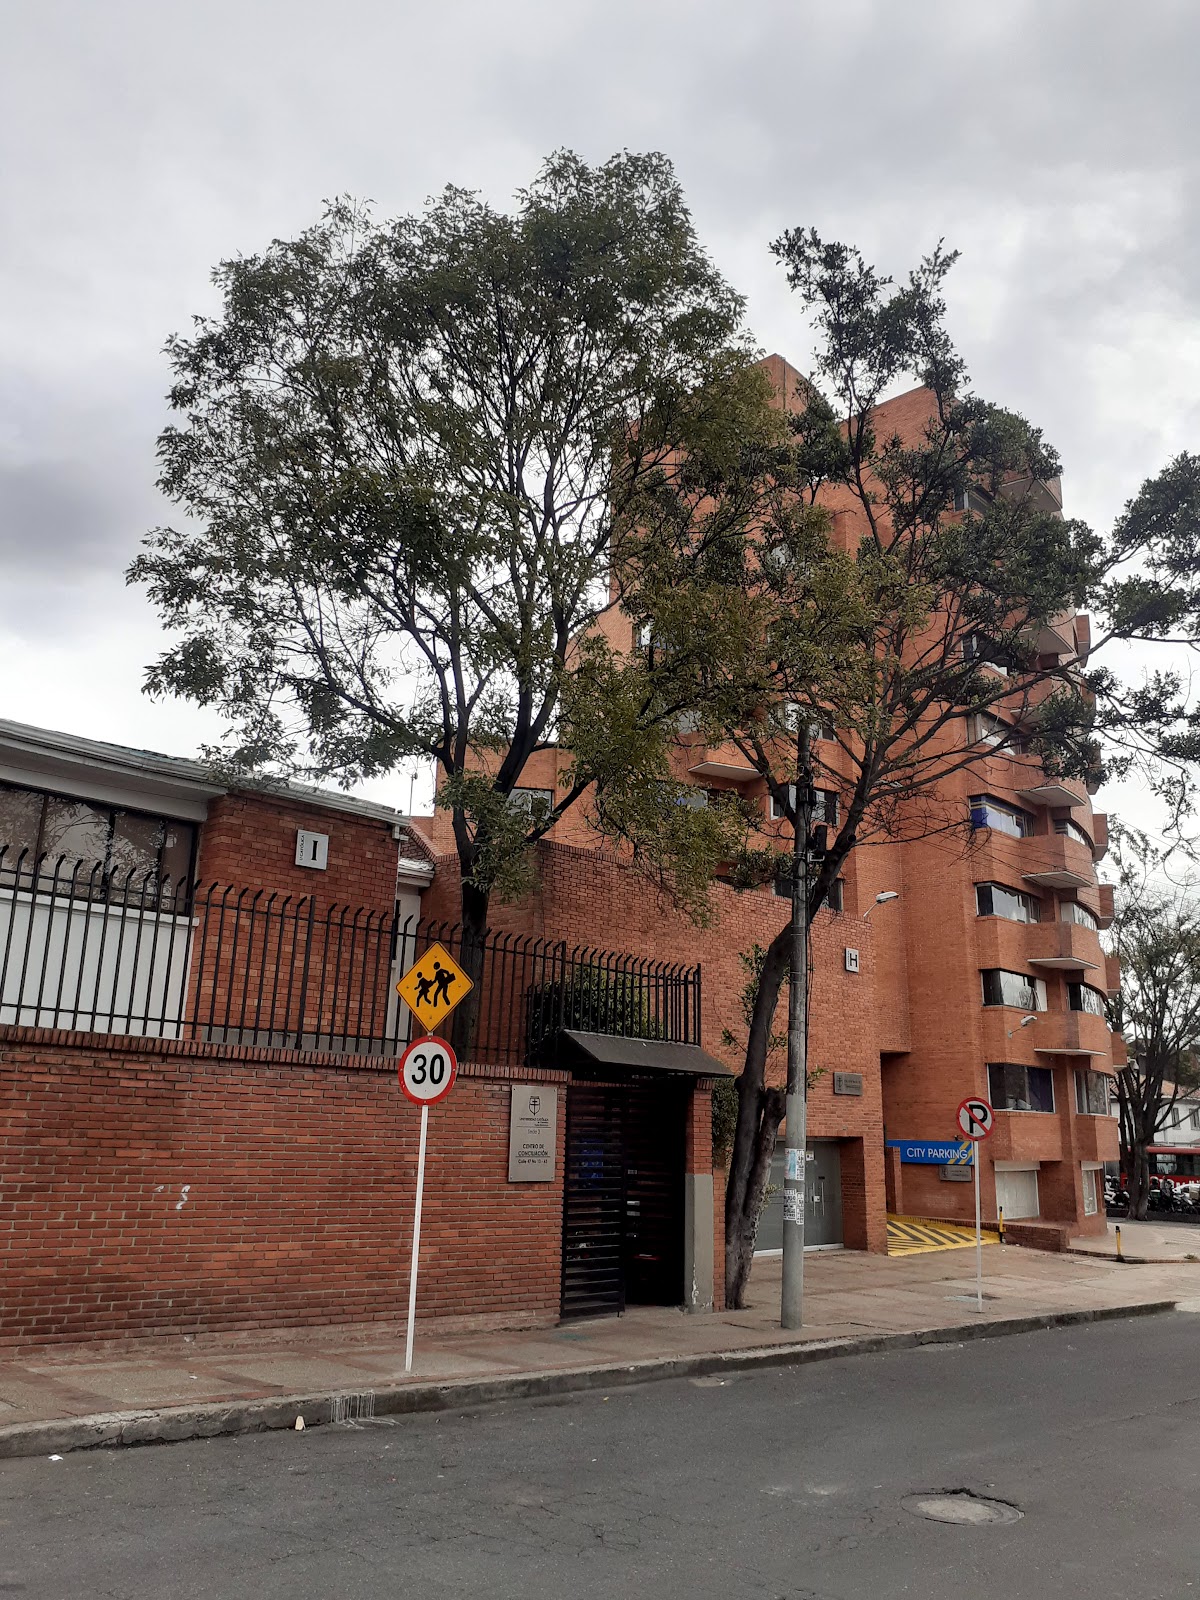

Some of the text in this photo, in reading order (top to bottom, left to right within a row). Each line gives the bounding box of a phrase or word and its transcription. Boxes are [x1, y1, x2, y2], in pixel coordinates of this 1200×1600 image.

[850, 952, 857, 967] H
[411, 1053, 445, 1085] 30
[969, 1104, 987, 1134] P
[906, 1147, 968, 1159] CITY PARKING
